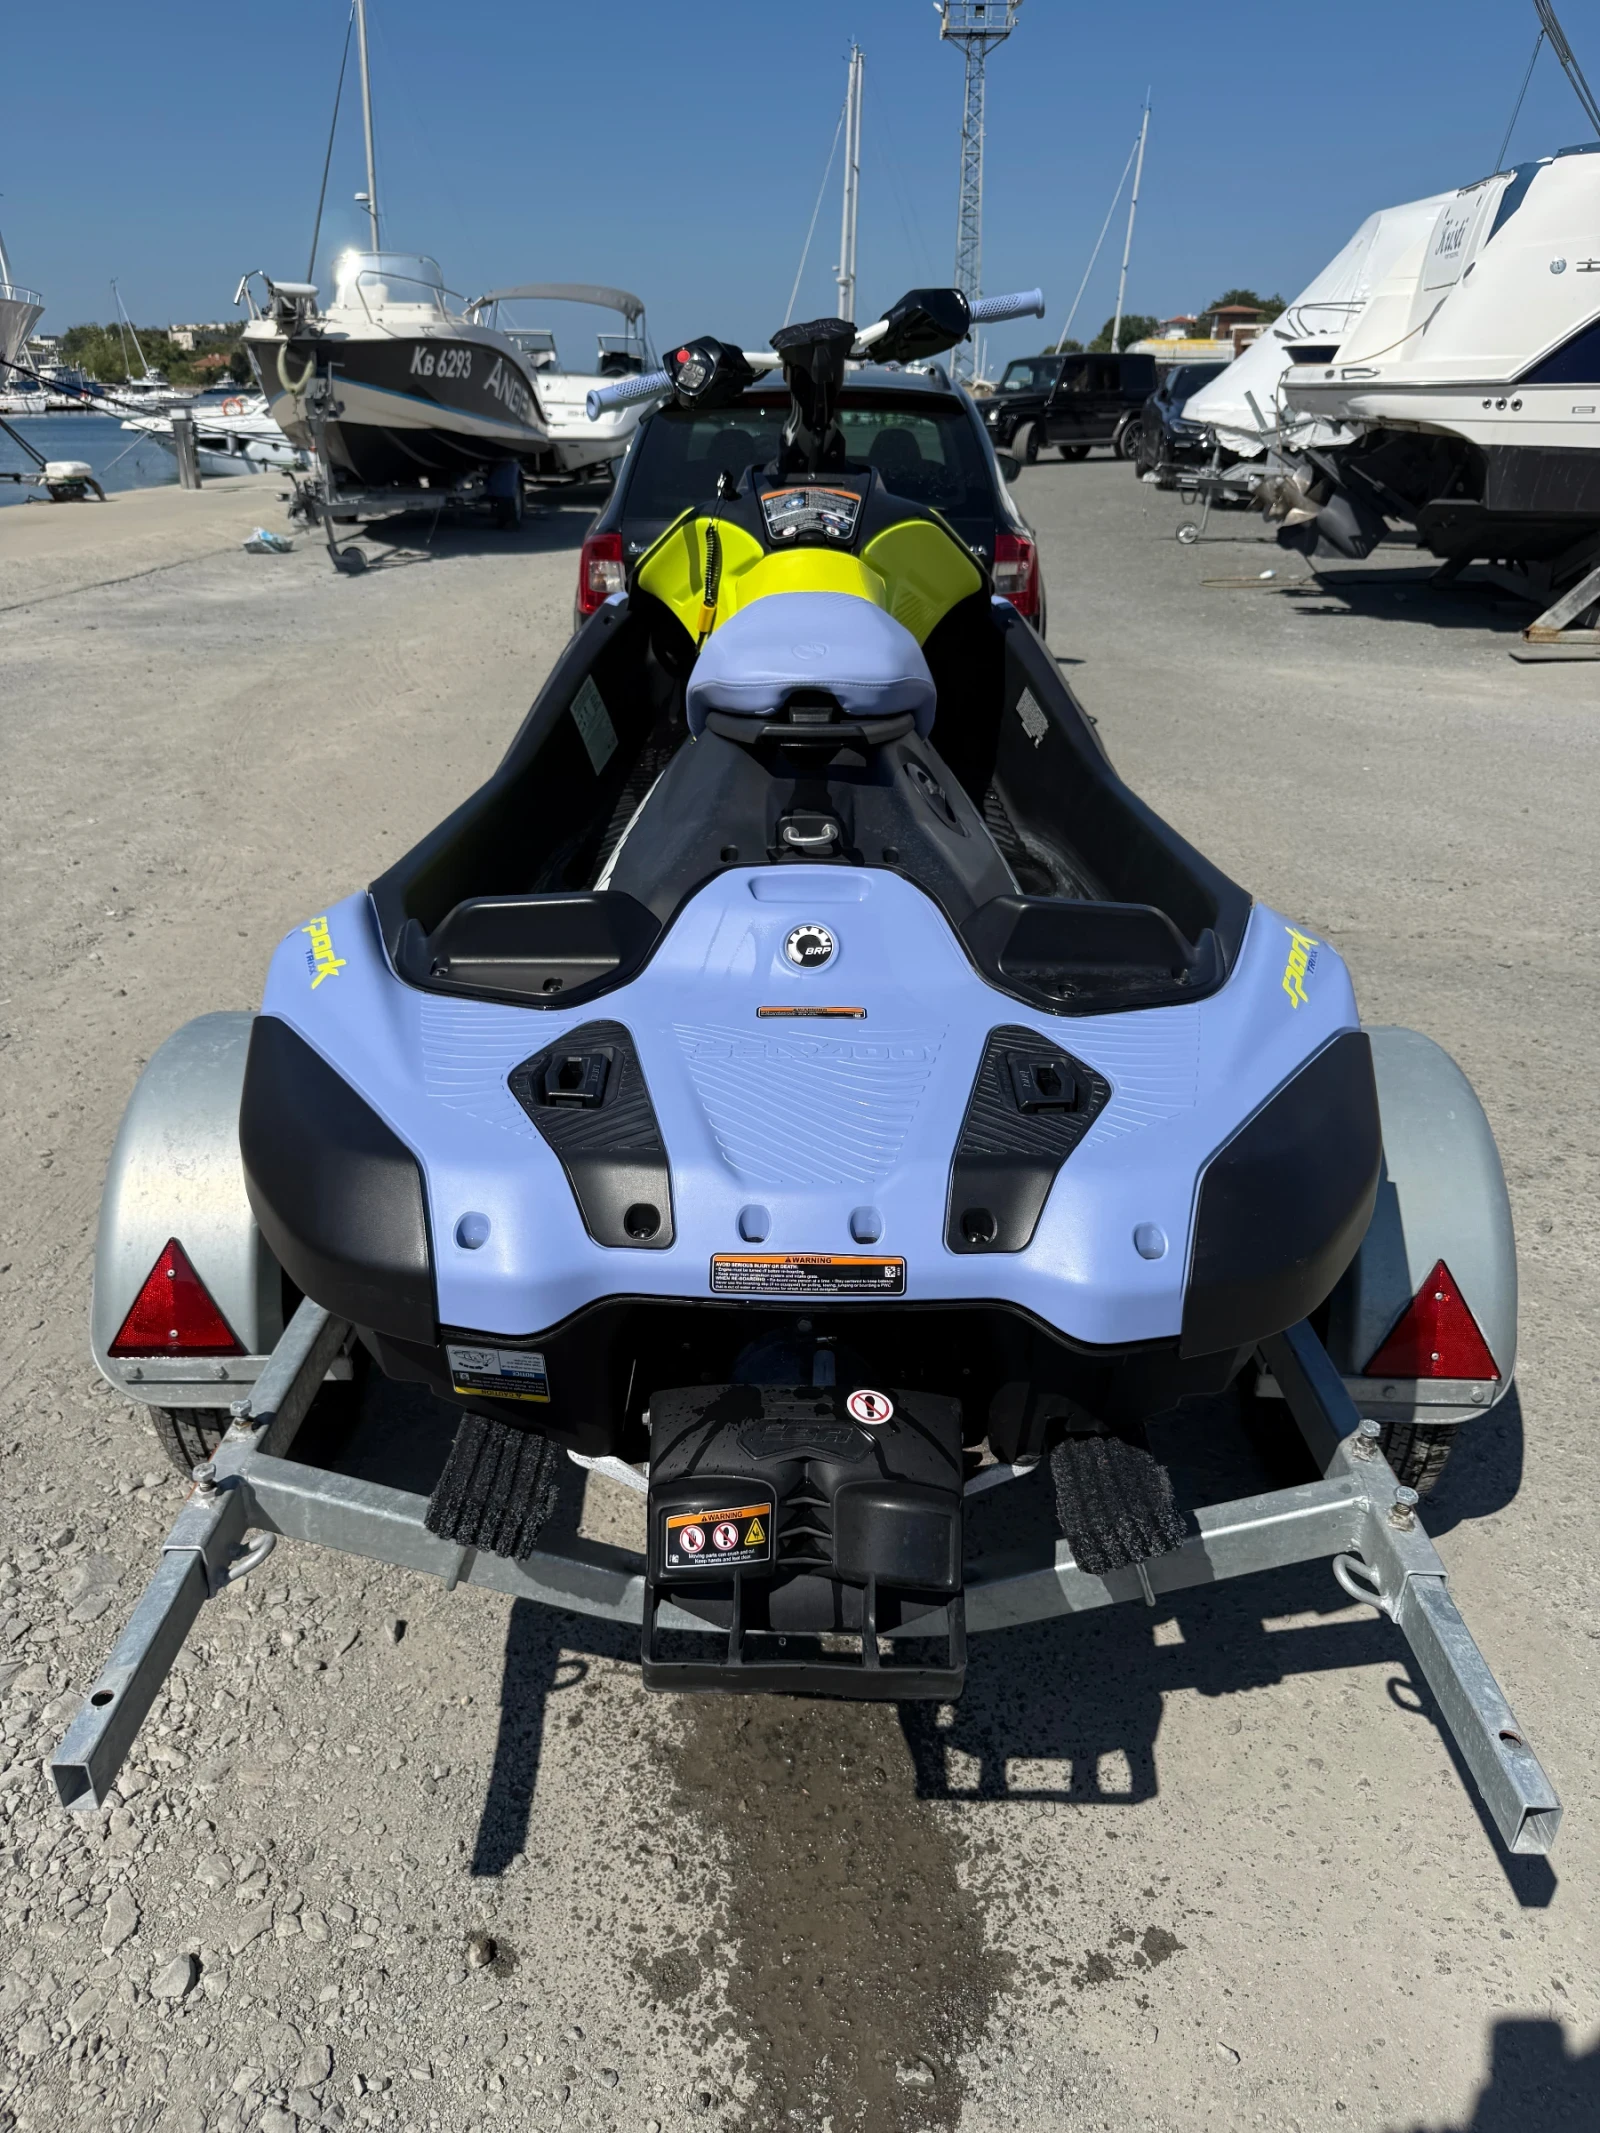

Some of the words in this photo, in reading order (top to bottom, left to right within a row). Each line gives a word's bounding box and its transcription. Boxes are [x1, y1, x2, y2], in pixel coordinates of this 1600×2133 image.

[437, 349, 472, 379] 6293
[805, 946, 831, 955] BRP
[1306, 949, 1319, 975] TRIXX
[707, 1511, 743, 1521] WARNING
